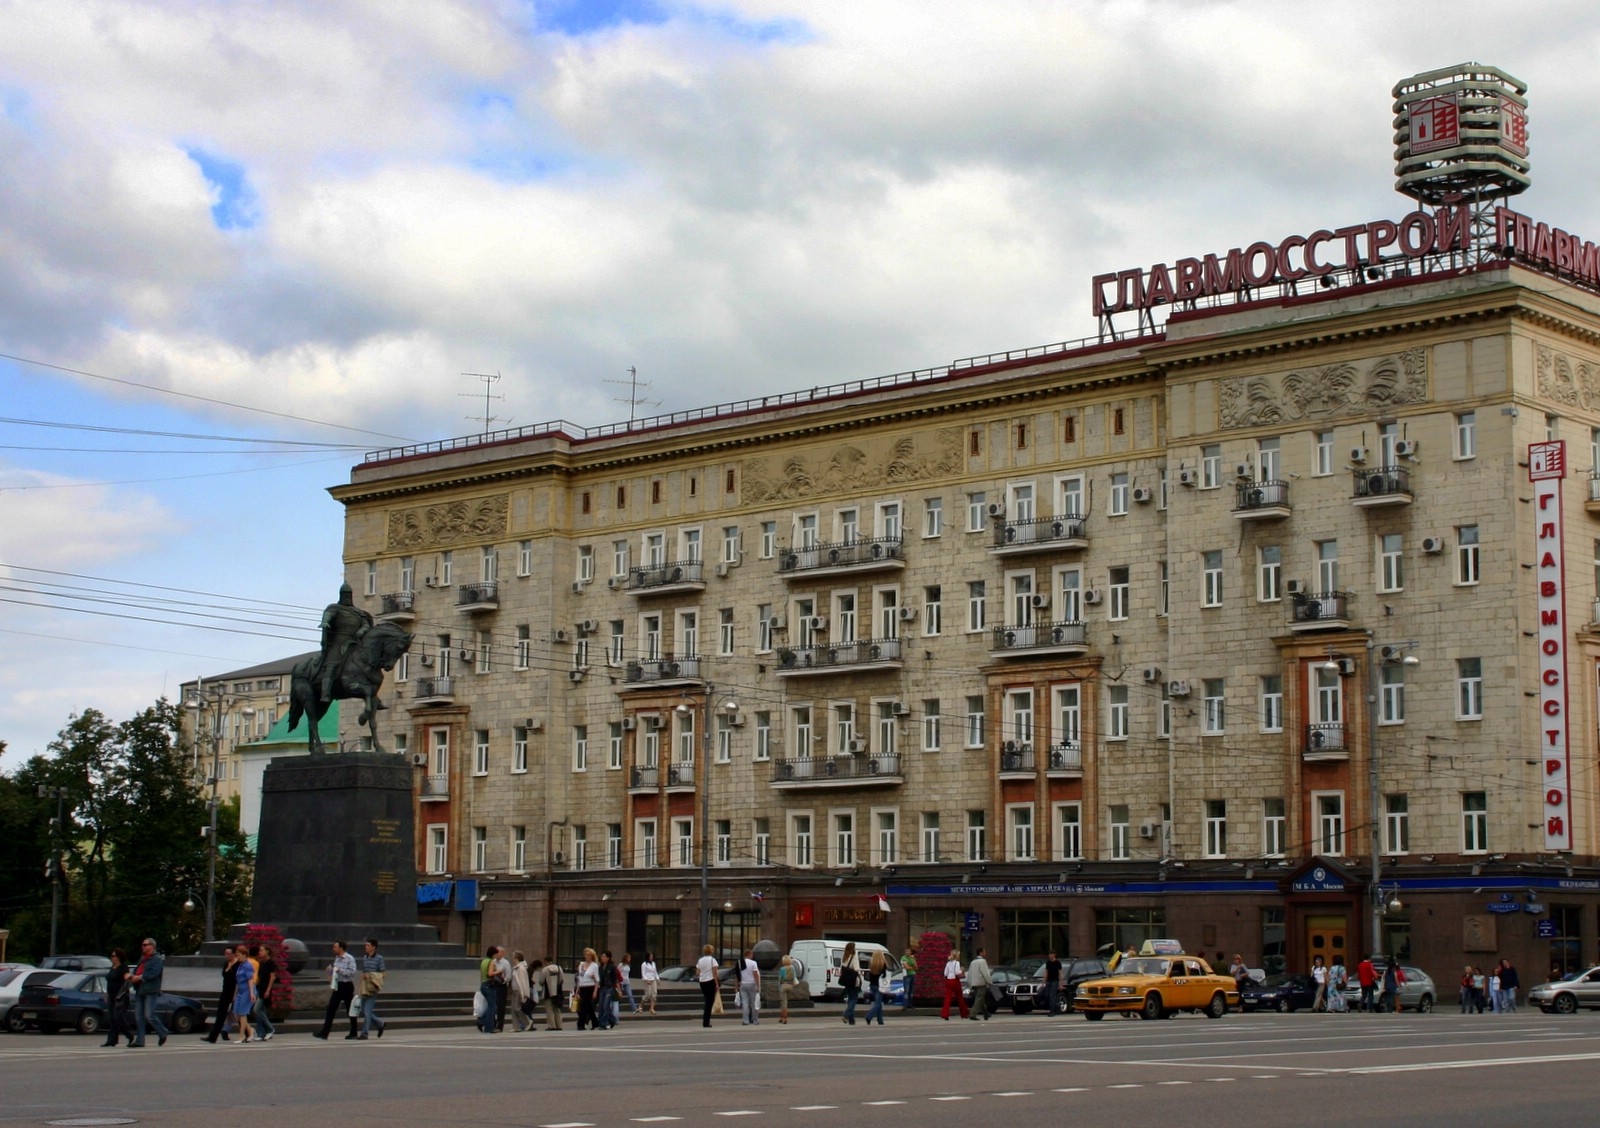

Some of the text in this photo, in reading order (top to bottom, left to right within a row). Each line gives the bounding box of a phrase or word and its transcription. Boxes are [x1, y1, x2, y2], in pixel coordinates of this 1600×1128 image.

[1092, 193, 1471, 316] ГЛАВМОССТРОЙ
[1495, 206, 1600, 284] ГЛАВМ
[1539, 493, 1563, 836] ГЛАВМОССТРОЙ
